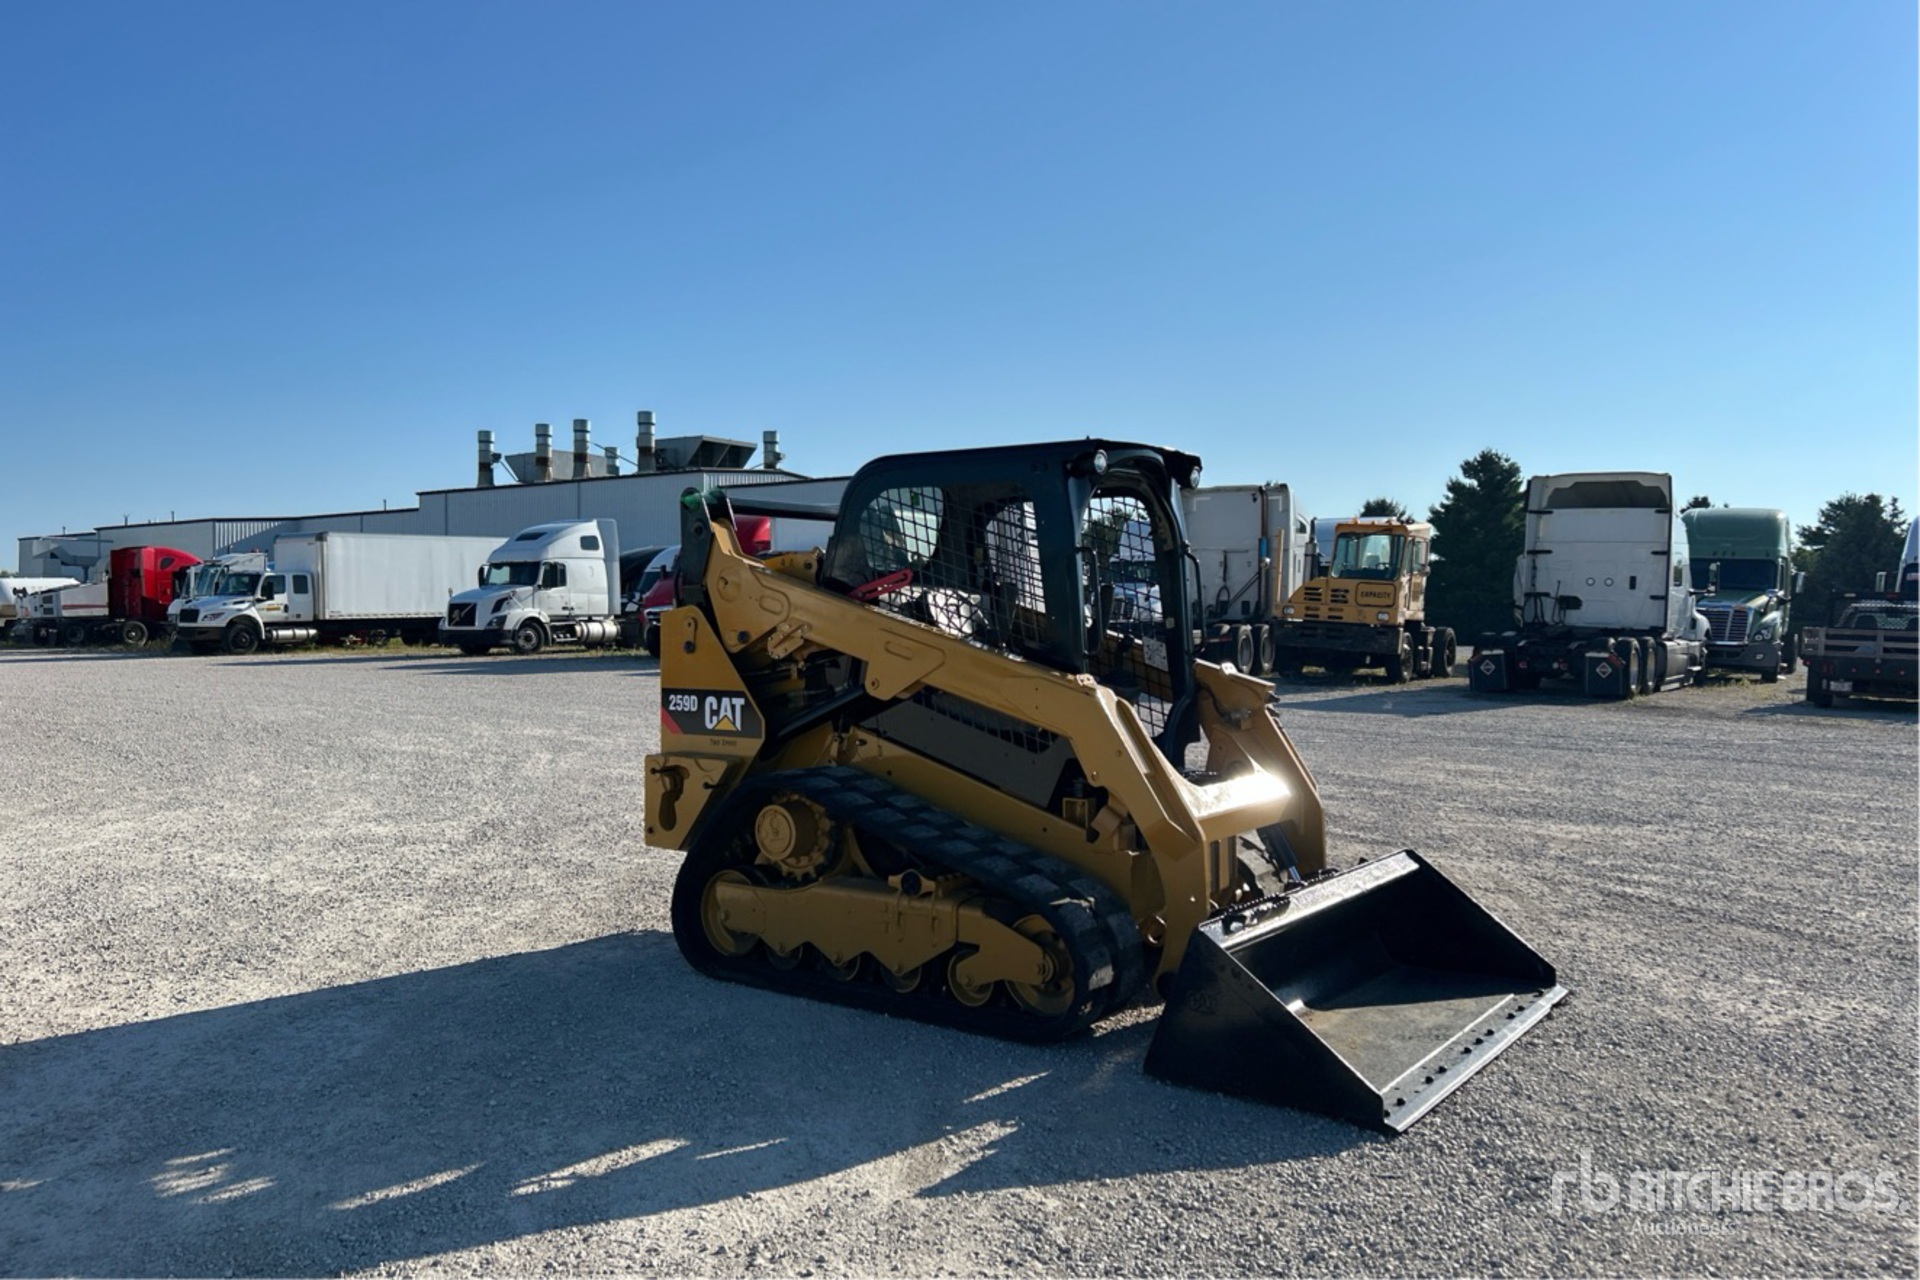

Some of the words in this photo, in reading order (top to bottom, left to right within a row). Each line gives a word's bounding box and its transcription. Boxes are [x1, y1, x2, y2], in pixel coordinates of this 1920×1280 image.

[1360, 591, 1391, 599] CAPACITY
[668, 694, 698, 711] 259D
[704, 696, 745, 731] CAT
